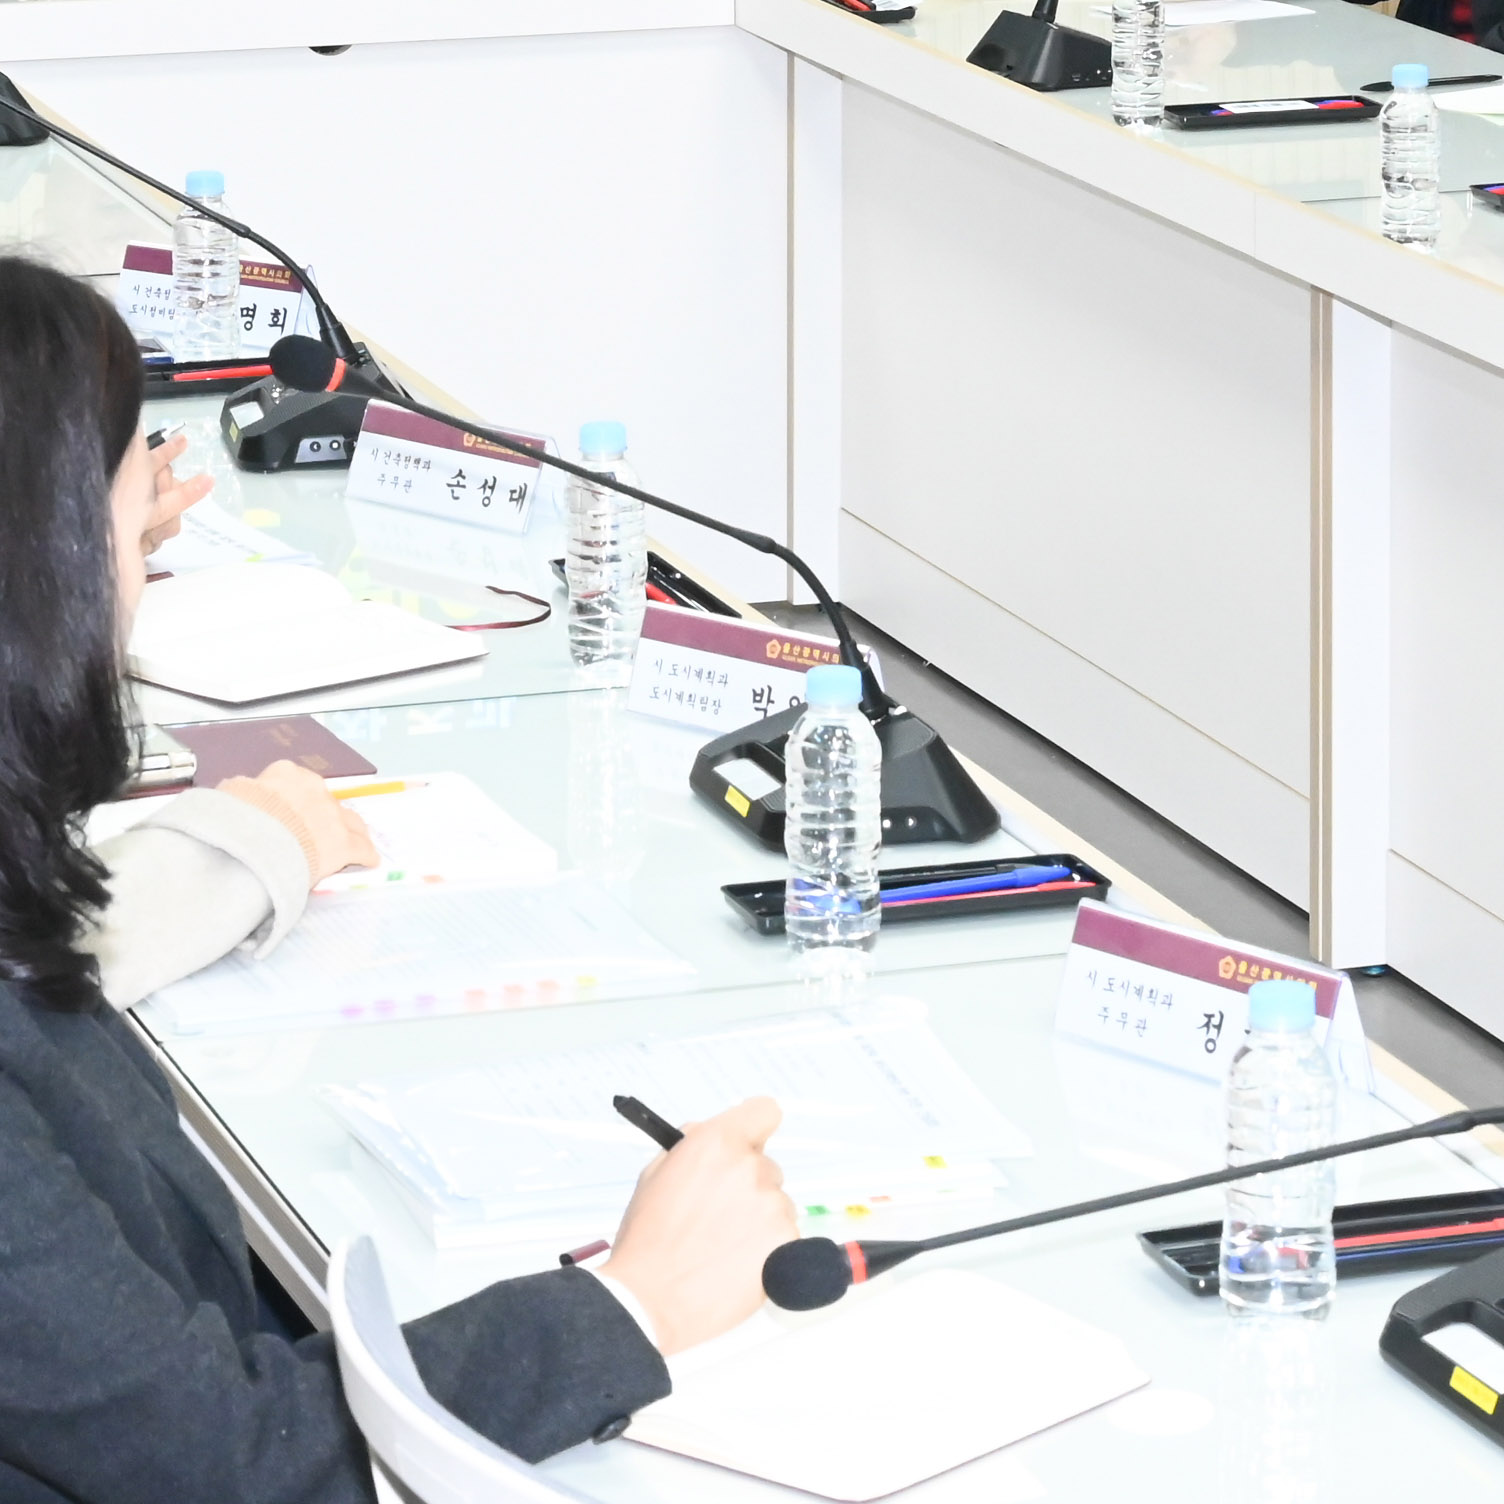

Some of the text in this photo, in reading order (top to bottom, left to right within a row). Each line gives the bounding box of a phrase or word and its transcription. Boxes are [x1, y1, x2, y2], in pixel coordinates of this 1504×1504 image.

[668, 663, 729, 688] 도시계획과
[649, 686, 722, 715] 도시계획팀장
[1103, 977, 1173, 1010] 도시계획과
